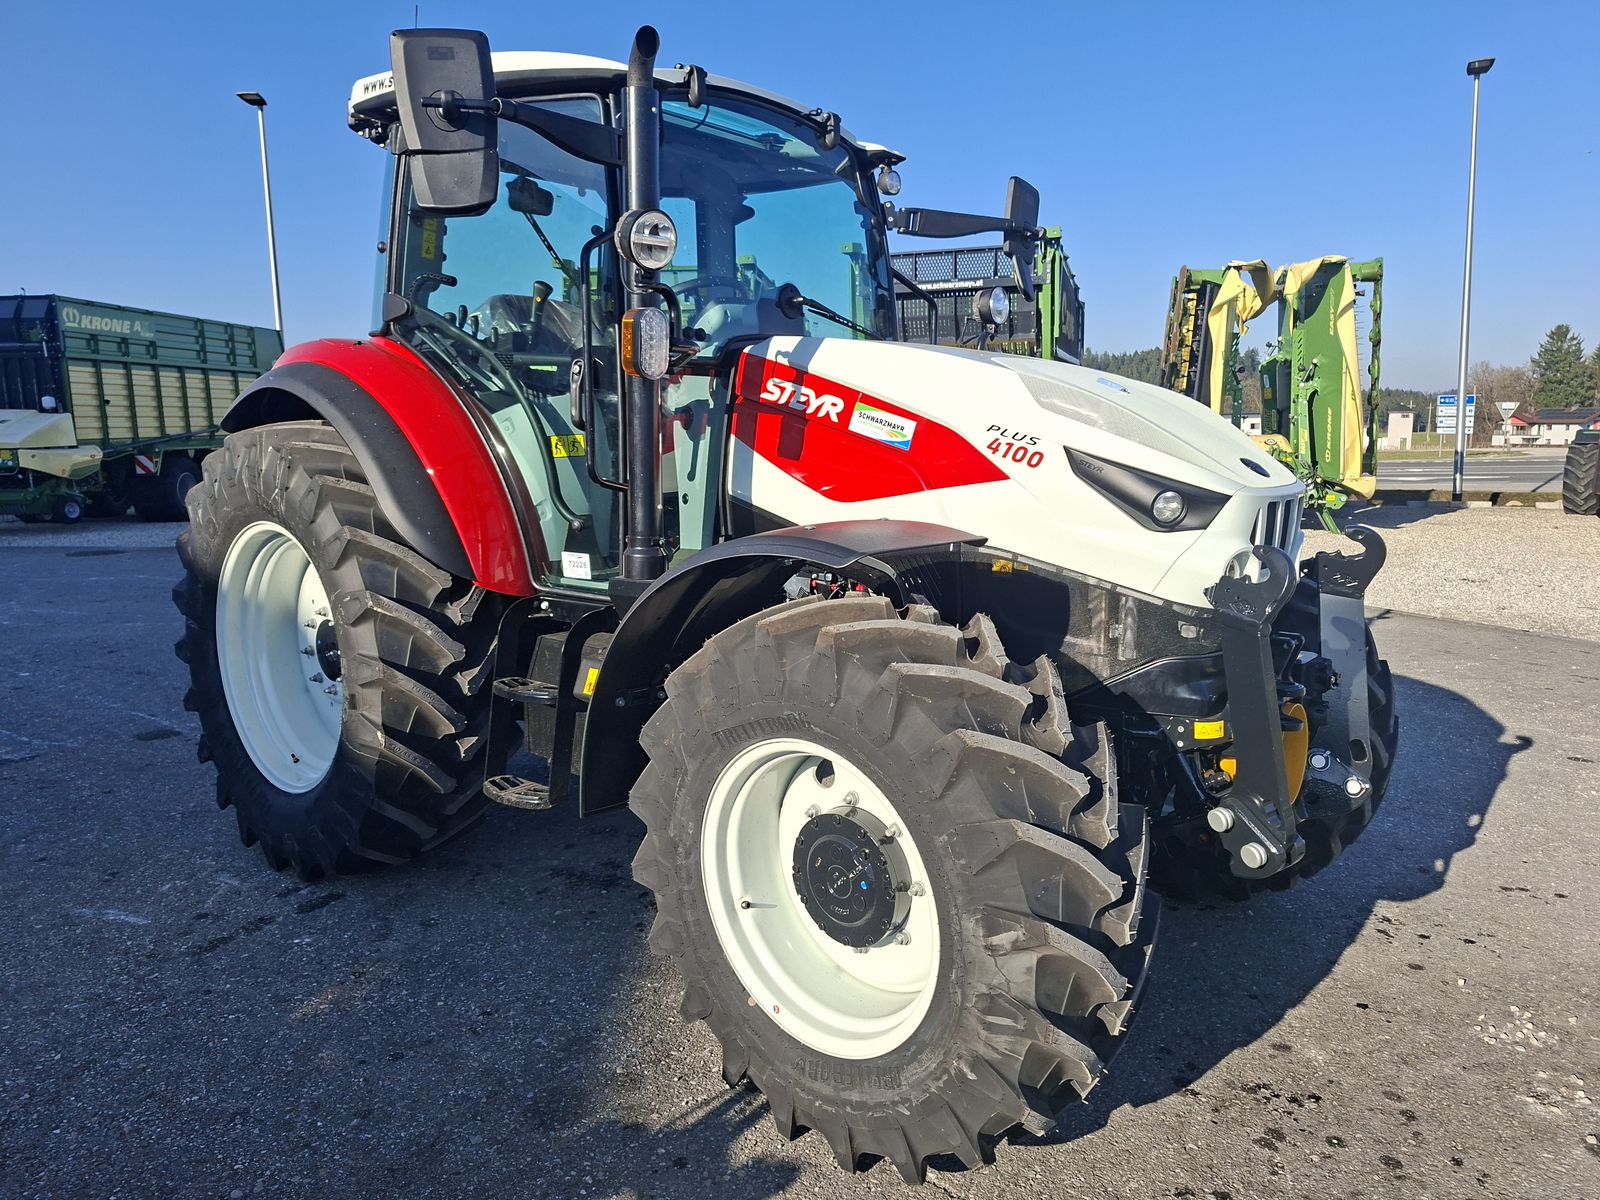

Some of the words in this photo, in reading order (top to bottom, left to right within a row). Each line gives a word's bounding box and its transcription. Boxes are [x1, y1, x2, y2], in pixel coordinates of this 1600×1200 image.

[81, 314, 131, 334] KRONE
[760, 377, 845, 423] STEYR
[858, 411, 905, 432] SCHWARZMAYR
[986, 424, 1041, 446] PLUS
[986, 438, 1045, 468] 4100
[1080, 459, 1105, 474] STEYR
